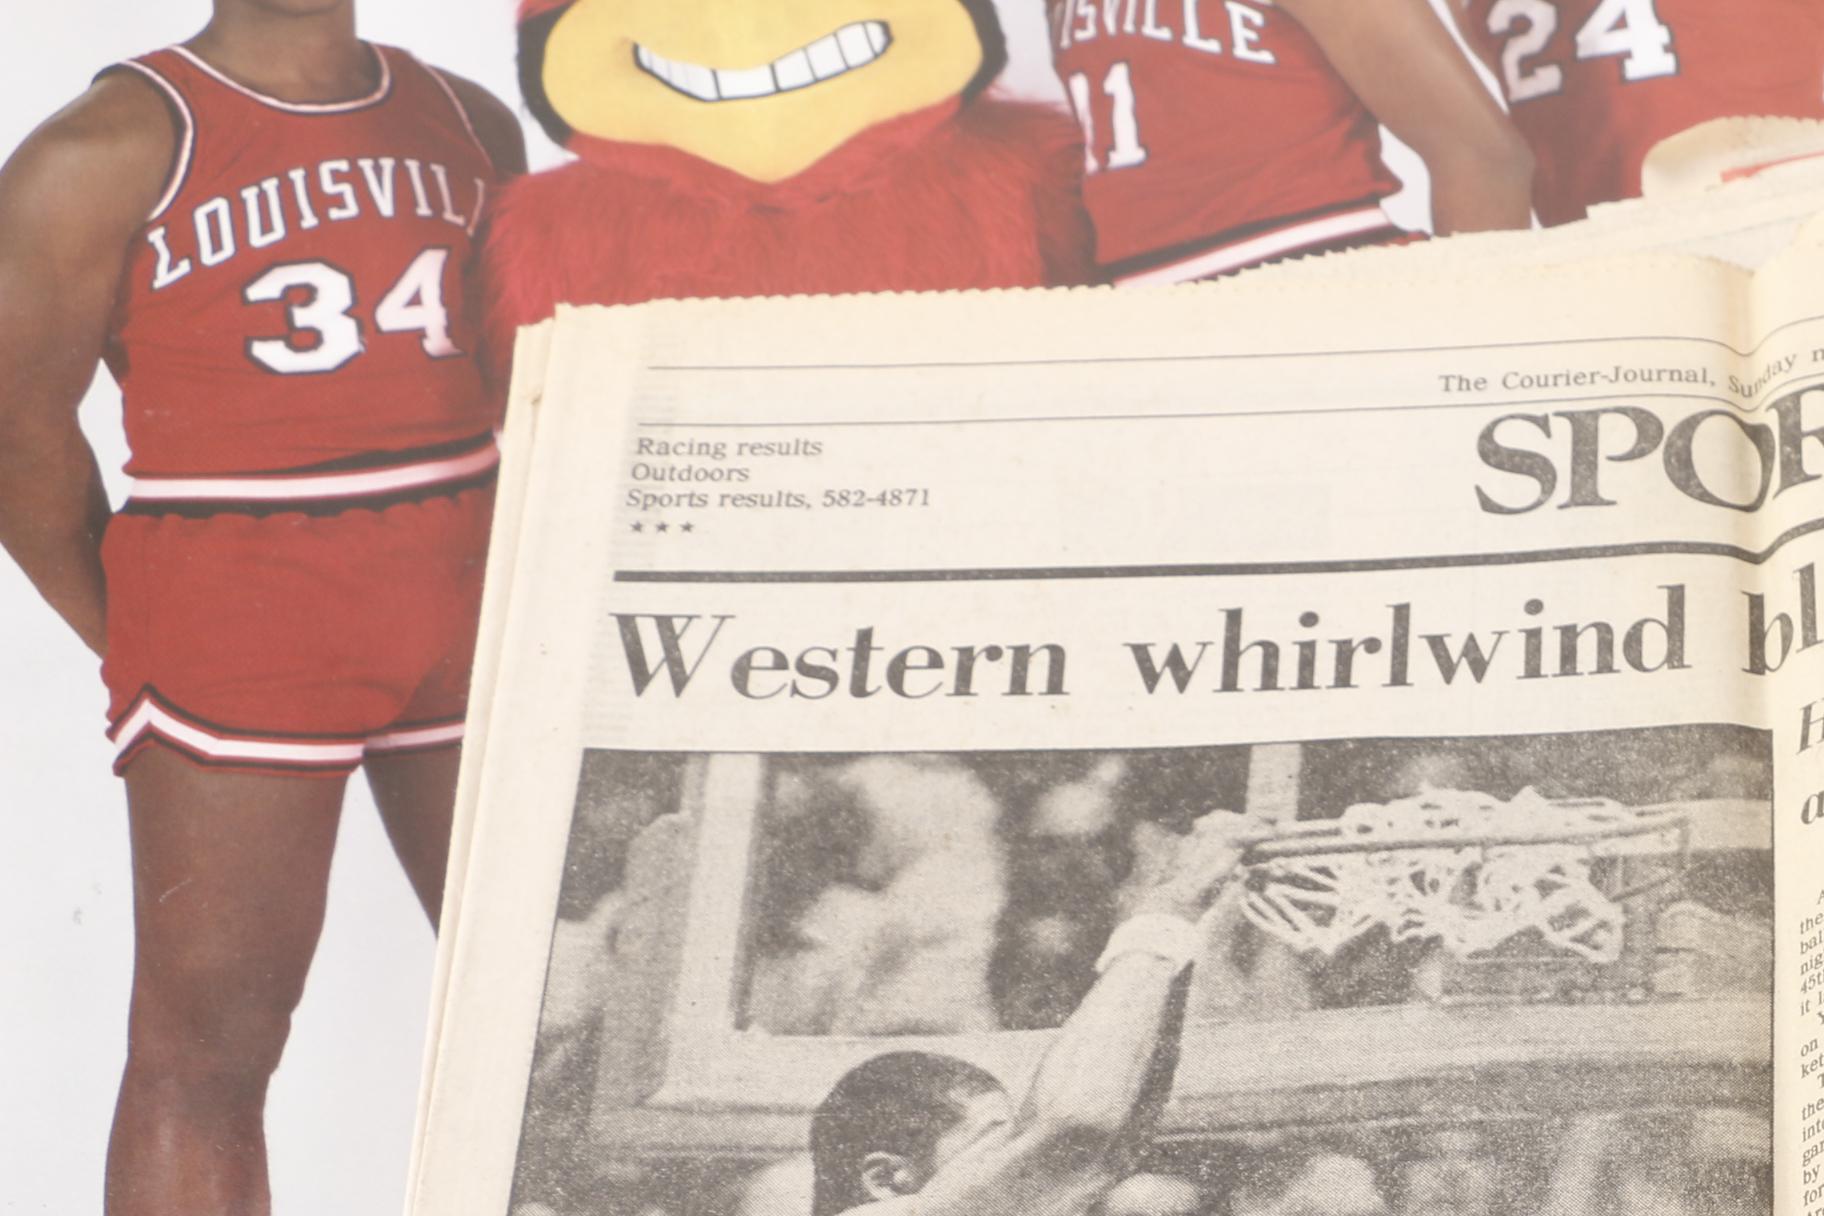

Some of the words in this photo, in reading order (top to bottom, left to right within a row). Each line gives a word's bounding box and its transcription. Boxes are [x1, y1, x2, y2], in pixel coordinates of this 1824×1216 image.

[1487, 0, 1676, 102] 24
[245, 248, 465, 374] 34
[1438, 374, 1489, 393] The
[1501, 365, 1718, 391] Courier-Journal,
[1728, 349, 1798, 397] Sunday
[630, 461, 750, 483] Outdoors
[633, 436, 727, 461] Racing
[736, 437, 824, 457] results
[625, 487, 709, 512] Sports
[717, 489, 813, 511] results,
[821, 487, 929, 508] 582-4871
[608, 612, 1070, 700] Western
[1130, 583, 1693, 695] whirlwind
